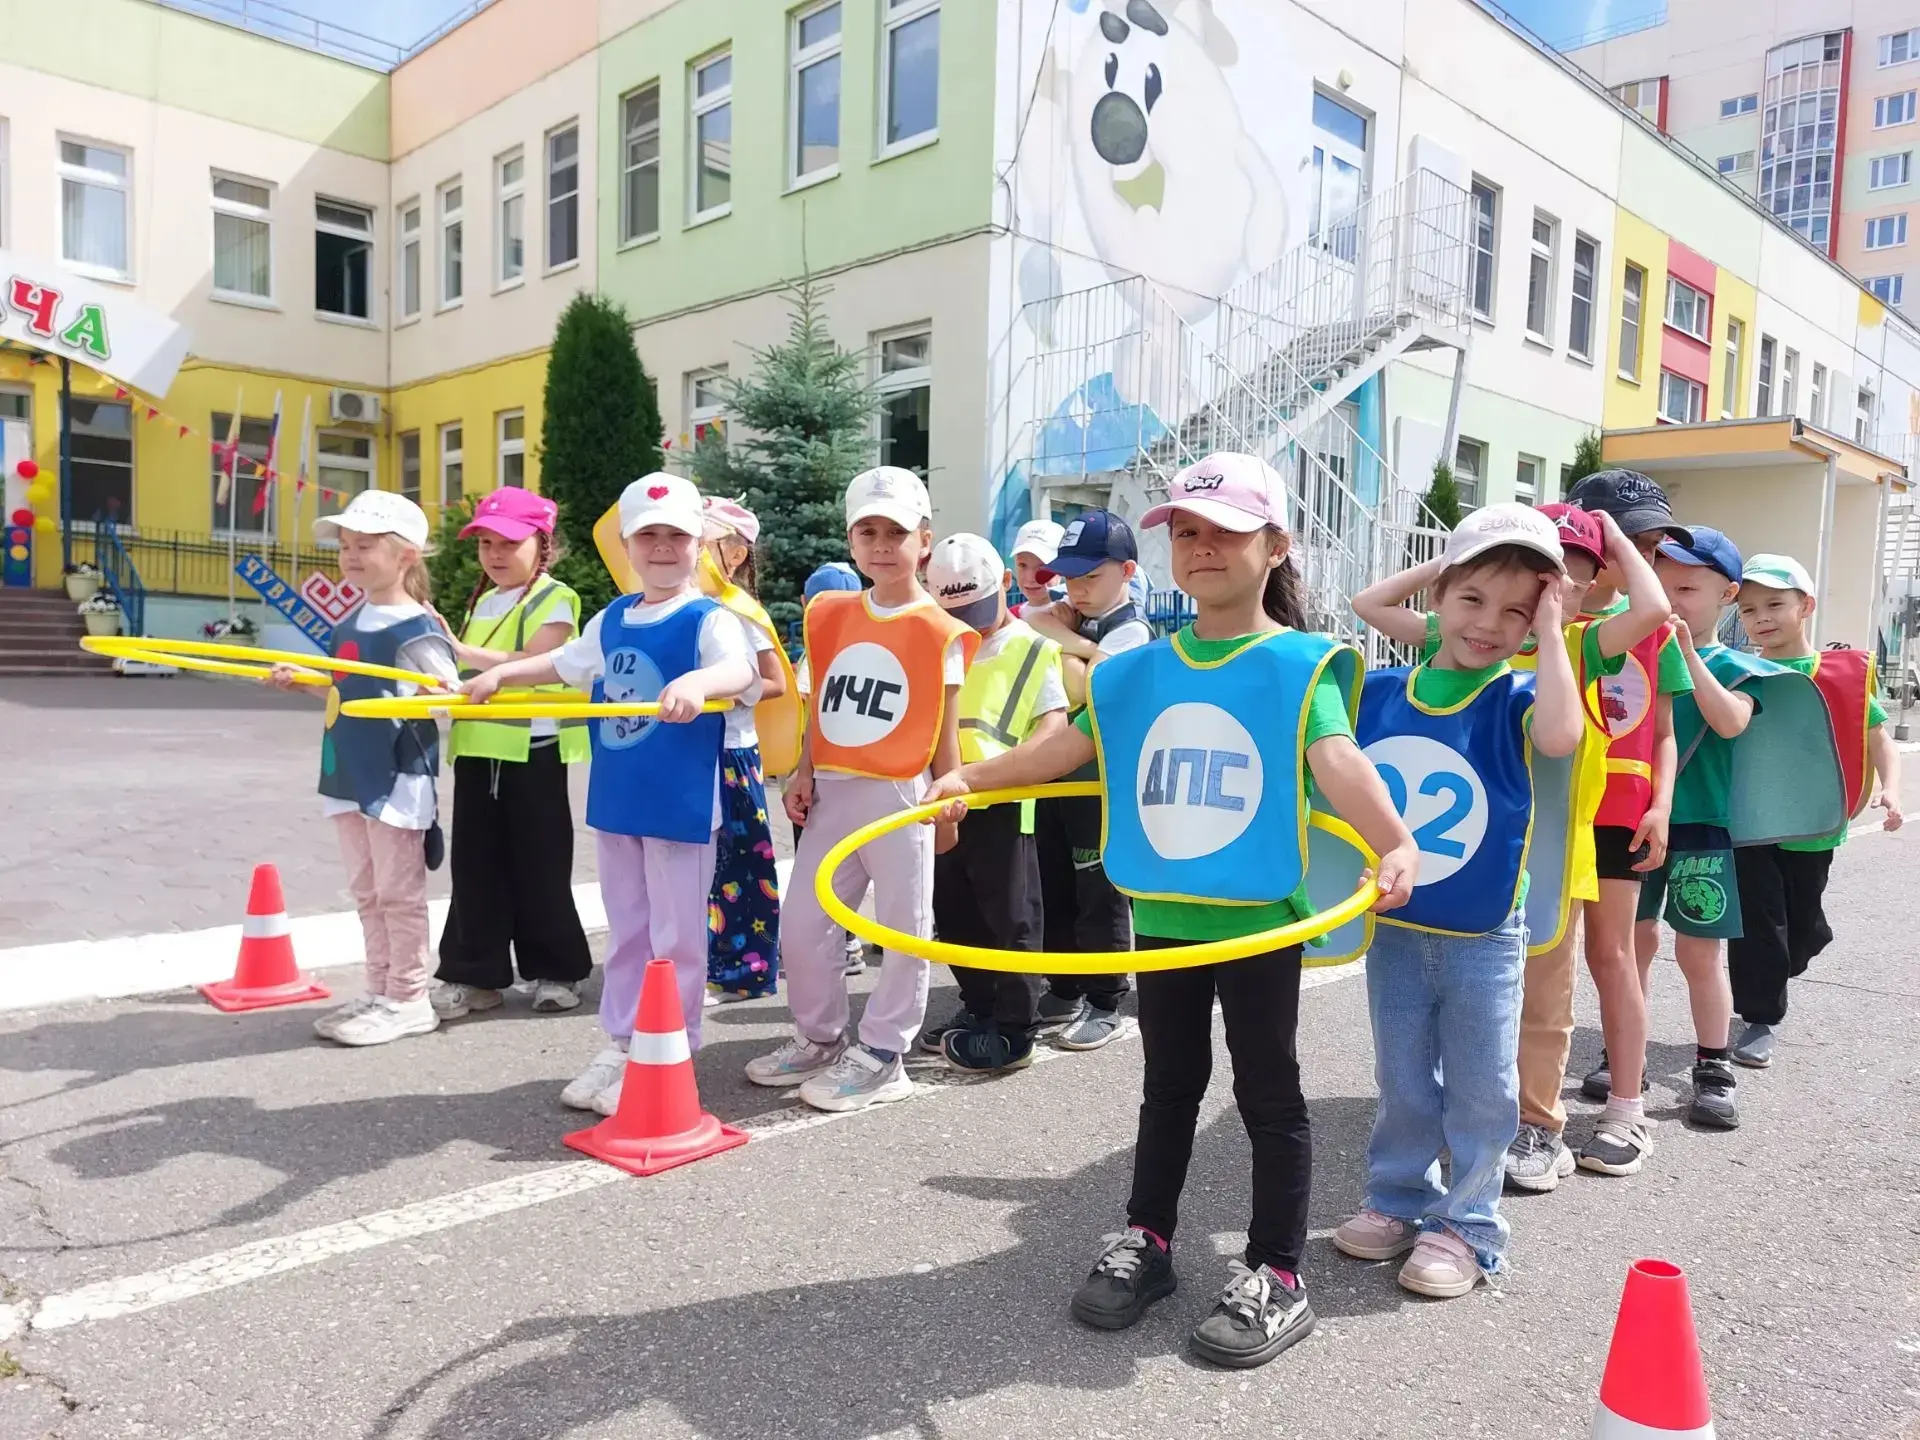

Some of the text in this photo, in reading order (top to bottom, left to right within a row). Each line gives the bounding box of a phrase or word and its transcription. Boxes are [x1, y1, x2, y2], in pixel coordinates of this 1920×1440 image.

[0, 275, 112, 360] ЧА
[244, 557, 330, 649] ЧУВАШИ
[612, 652, 637, 675] 02
[822, 675, 902, 722] МЧС
[1142, 748, 1249, 812] ДПС
[1669, 856, 1724, 879] HULK
